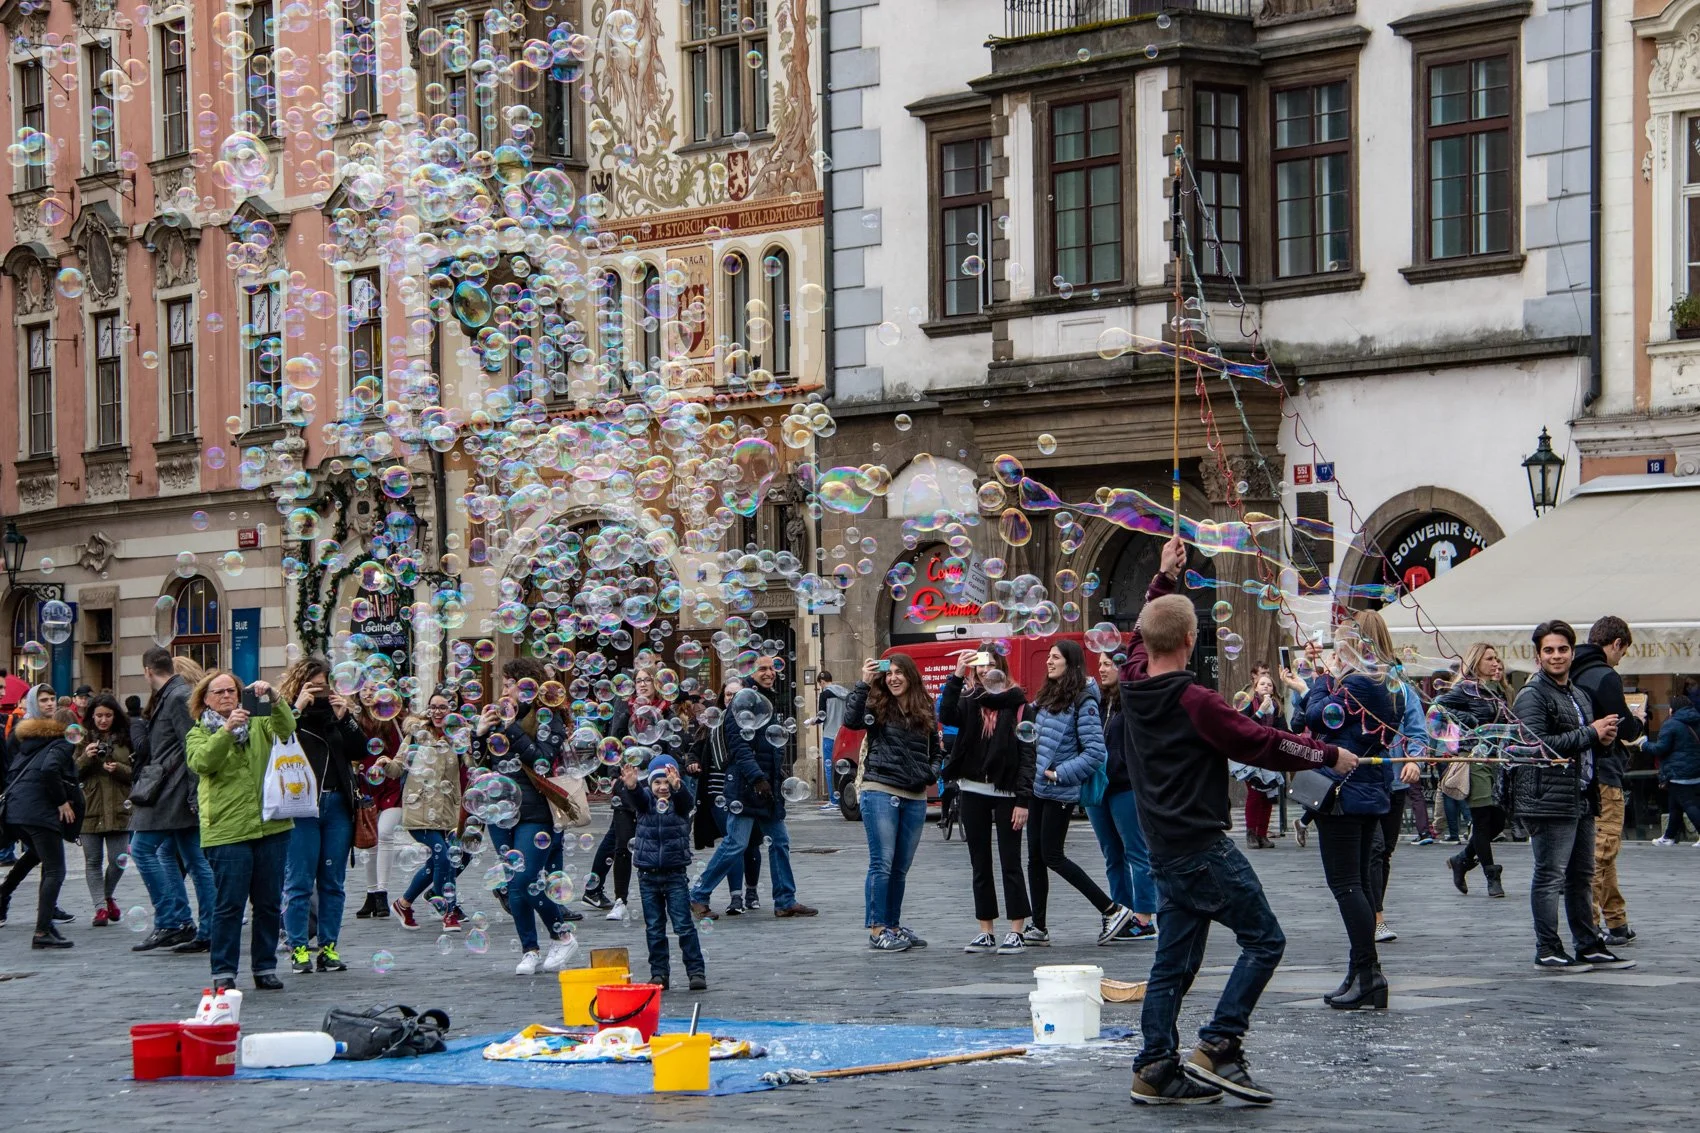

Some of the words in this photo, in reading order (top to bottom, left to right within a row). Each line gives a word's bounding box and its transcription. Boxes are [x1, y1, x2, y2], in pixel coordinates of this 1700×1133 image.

[1321, 466, 1328, 474] 17
[1650, 462, 1660, 472] 18
[1392, 522, 1460, 566] SOUVENIR
[234, 621, 248, 630] BLUE
[361, 623, 394, 633] Leather
